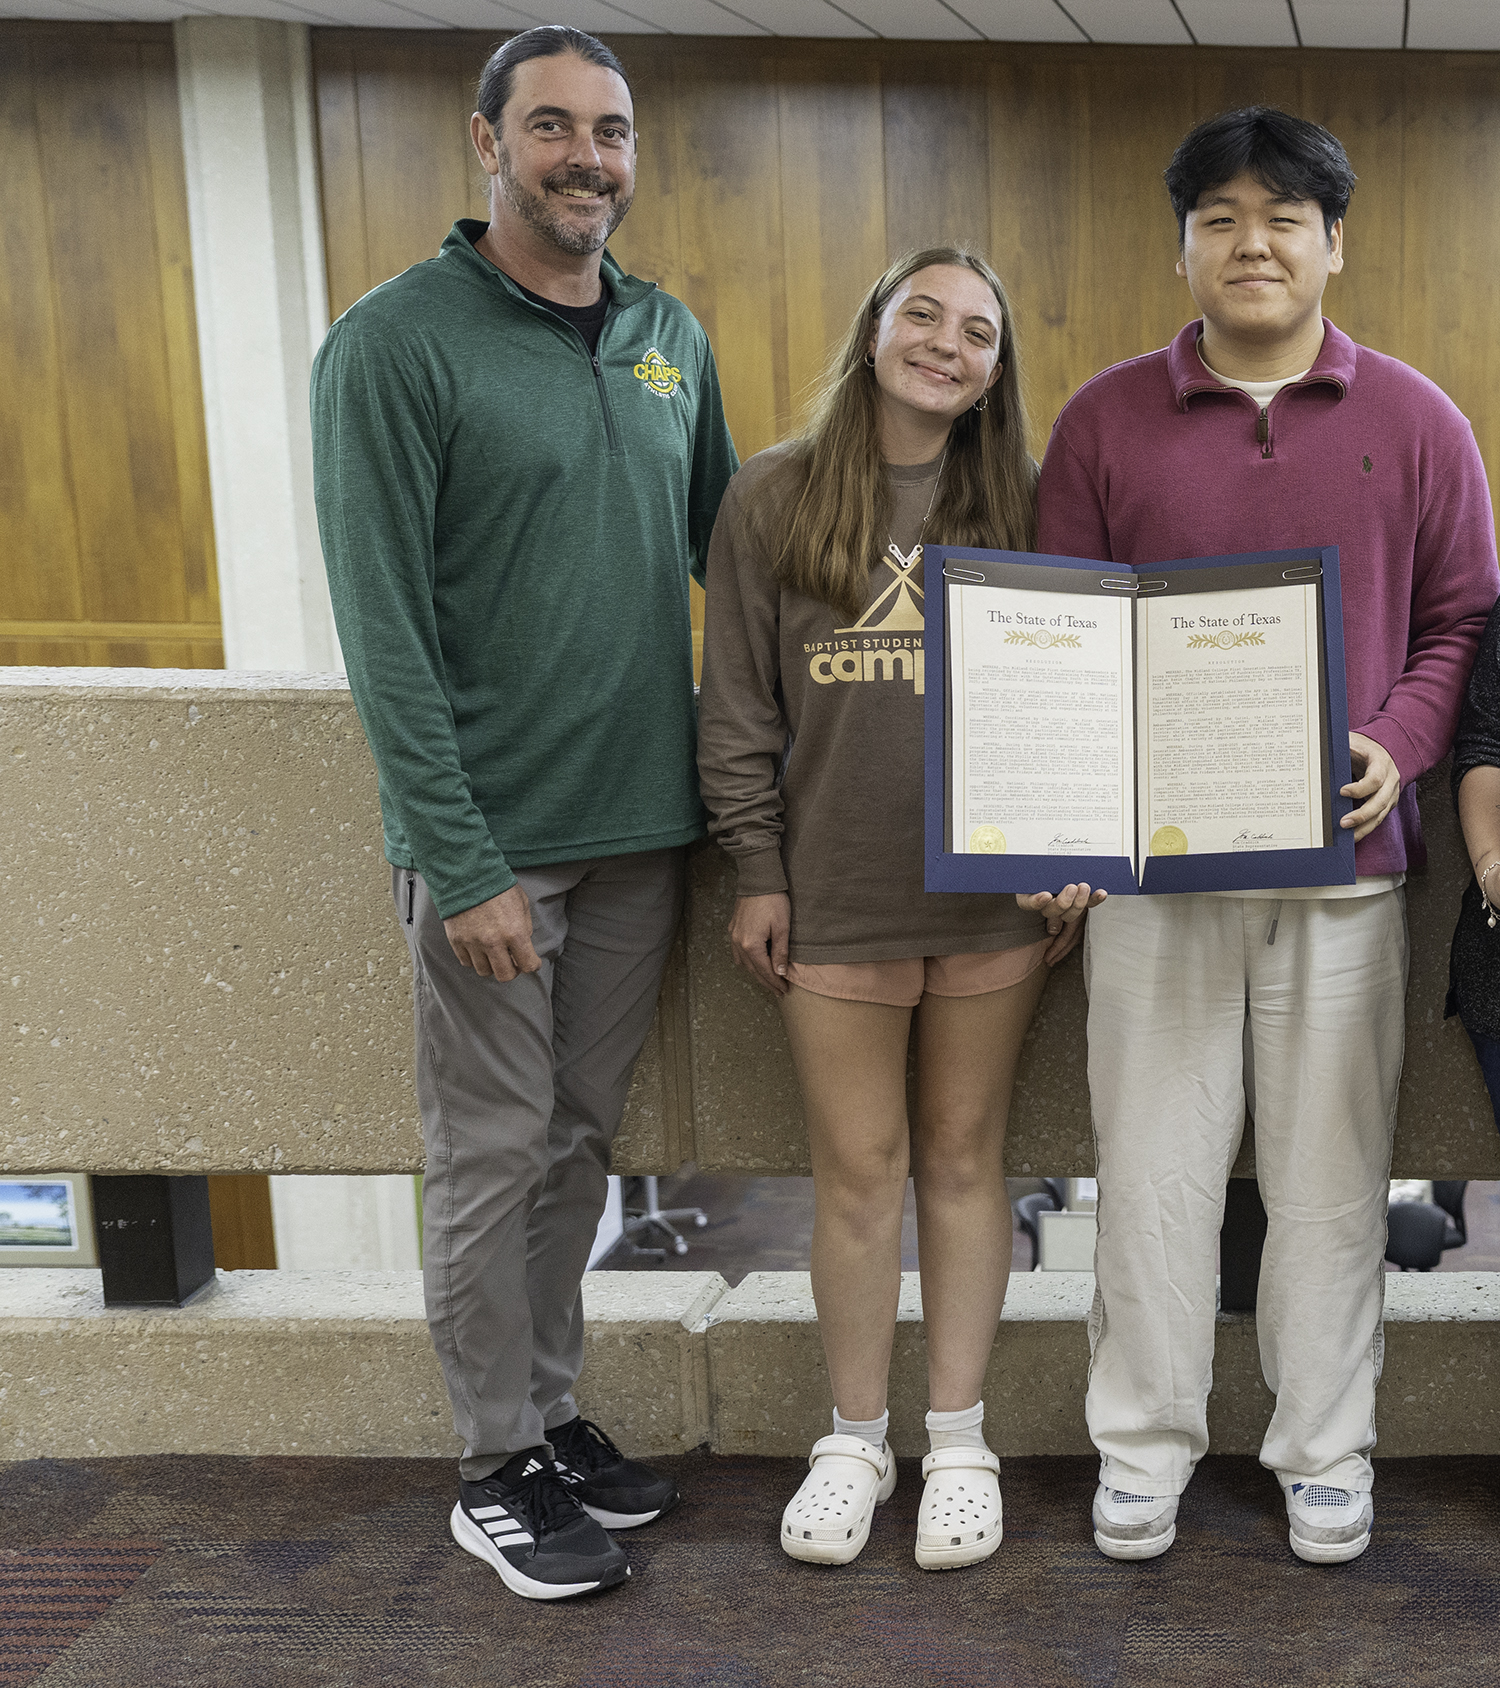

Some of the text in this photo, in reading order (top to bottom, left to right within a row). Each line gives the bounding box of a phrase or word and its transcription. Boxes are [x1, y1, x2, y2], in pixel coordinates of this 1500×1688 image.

[633, 363, 682, 383] CHAPS
[987, 610, 1098, 629] The State of Texas
[1170, 613, 1281, 629] The State of Texas
[803, 638, 922, 653] BAPTIST STUDEN
